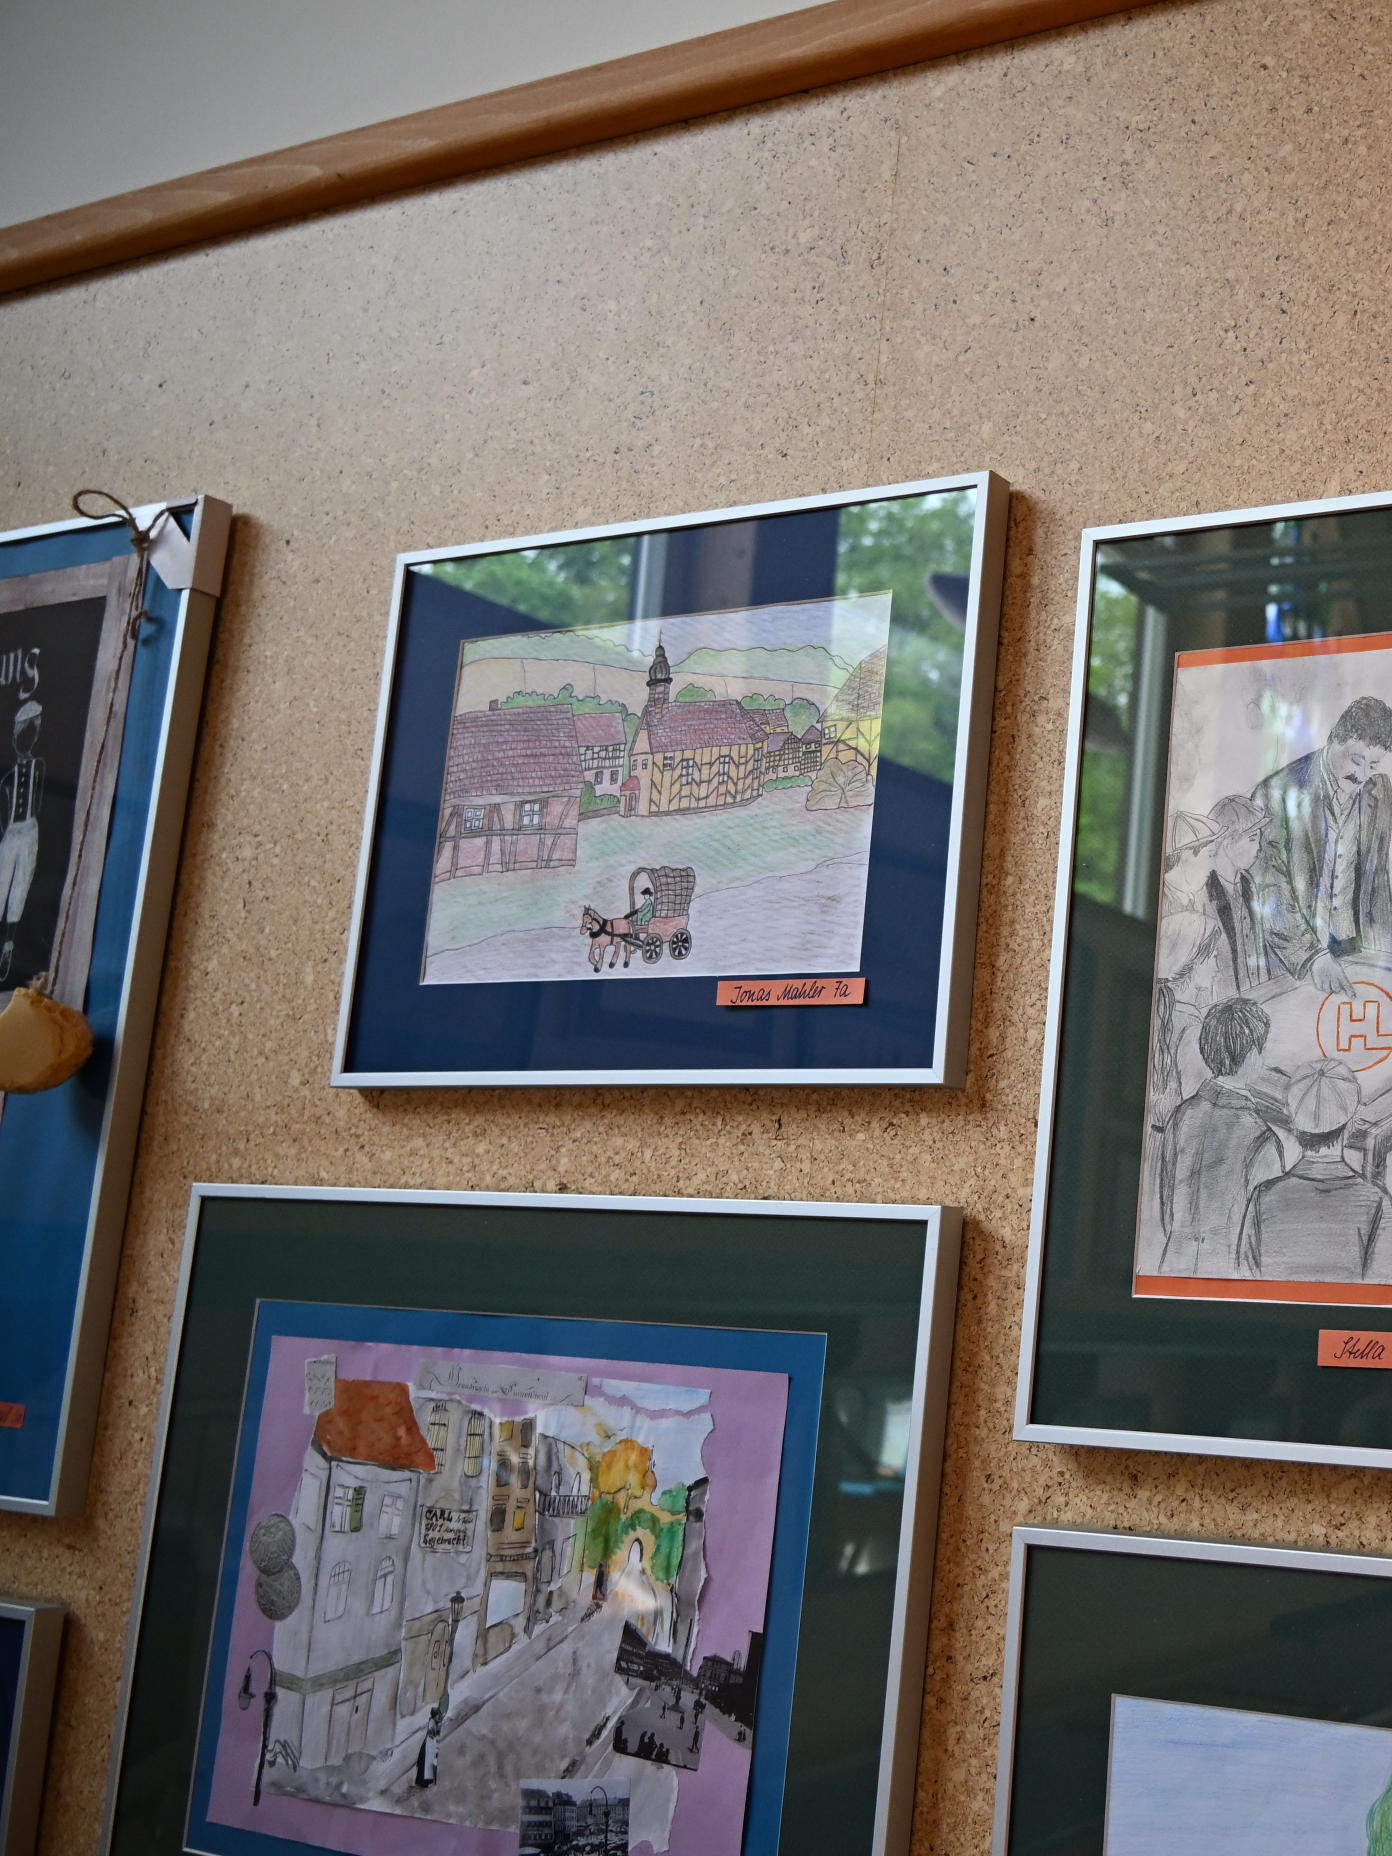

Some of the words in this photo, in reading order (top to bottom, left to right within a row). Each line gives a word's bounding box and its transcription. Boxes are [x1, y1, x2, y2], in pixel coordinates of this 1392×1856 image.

[730, 986, 773, 1004] Jonas
[777, 980, 827, 1001] Mahler
[1333, 1336, 1385, 1360] Stella
